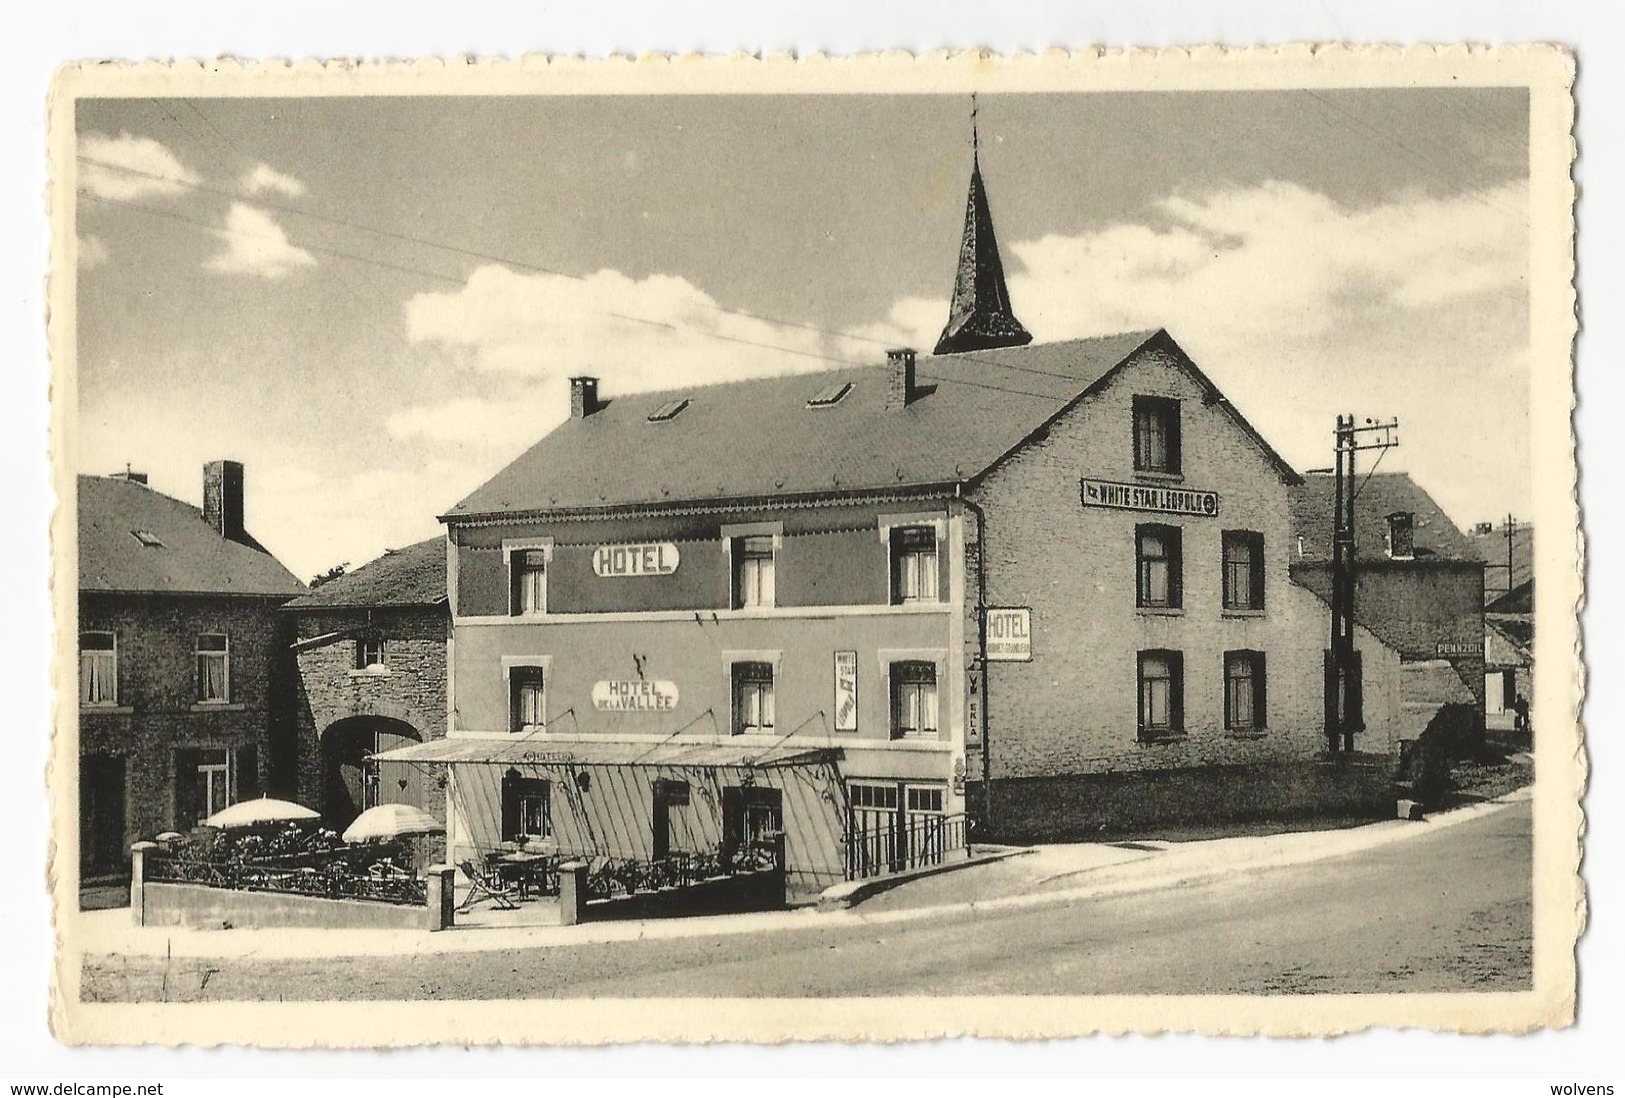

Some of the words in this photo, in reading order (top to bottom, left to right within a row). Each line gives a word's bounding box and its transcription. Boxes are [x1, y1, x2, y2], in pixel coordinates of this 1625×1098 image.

[1100, 484, 1130, 506] WHITE
[1133, 488, 1157, 508] STAR
[1160, 491, 1202, 512] LEOPOLD
[599, 545, 672, 575] HOTEL
[988, 613, 1028, 638] HOTEL
[609, 681, 662, 696] HOTEL
[620, 695, 673, 710] VALLEE
[969, 702, 977, 736] EKLA
